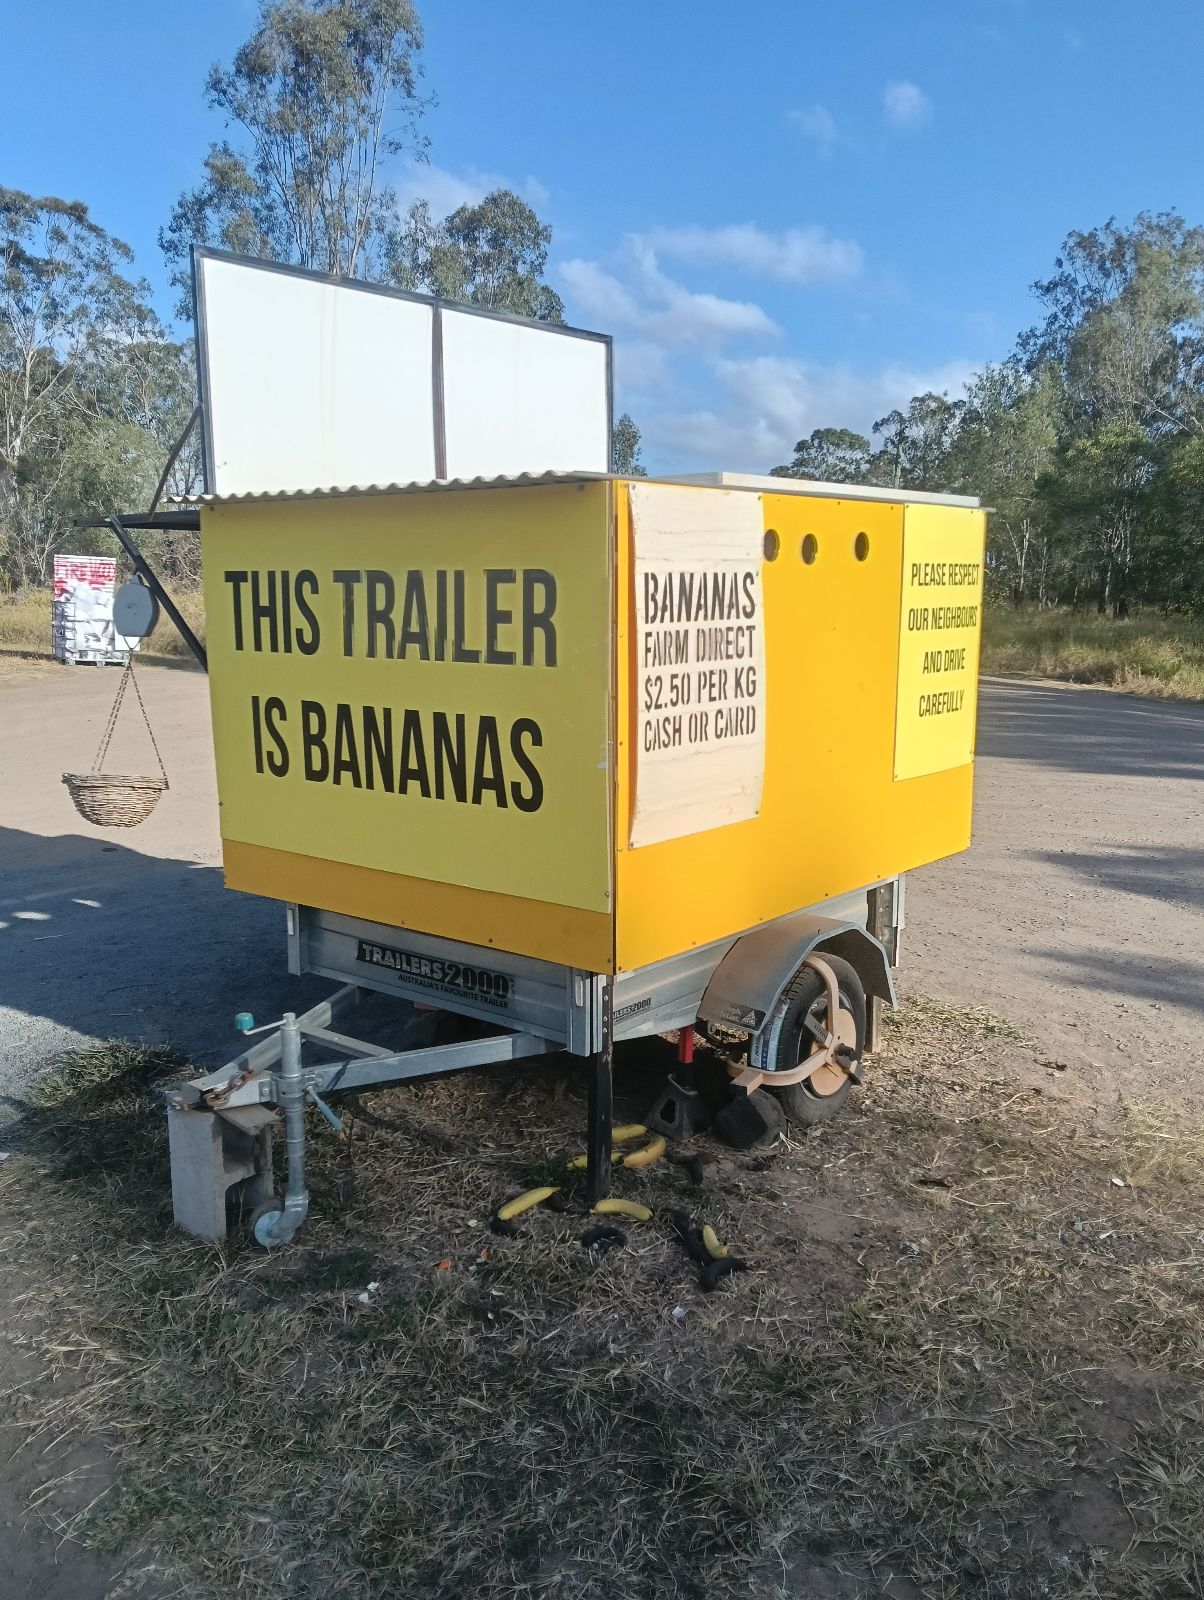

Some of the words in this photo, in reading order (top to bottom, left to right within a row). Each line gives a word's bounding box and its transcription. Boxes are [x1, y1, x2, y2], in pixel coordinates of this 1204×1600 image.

[911, 562, 946, 586] PLEASE
[948, 563, 980, 586] RESPECT
[224, 569, 320, 655] THIS
[333, 568, 558, 667] TRAILER
[644, 571, 756, 625] BANANAS
[908, 607, 929, 631] OUR
[931, 605, 978, 630] NEIGHBOURS
[644, 630, 689, 669] FARM
[696, 625, 756, 662] DIRECT
[923, 650, 942, 674] AND
[944, 648, 966, 672] DRIVE
[644, 671, 691, 713] $2.50
[697, 668, 728, 704] PER
[735, 665, 757, 699] KG
[918, 689, 965, 718] CAREFULLY
[644, 714, 682, 753] CASH
[688, 711, 709, 744] OR
[715, 705, 756, 740] CARD
[251, 695, 290, 778] IS
[301, 699, 544, 813] BANANAS
[440, 984, 479, 1000] FAVOURITE
[478, 995, 509, 1009] TRAILER
